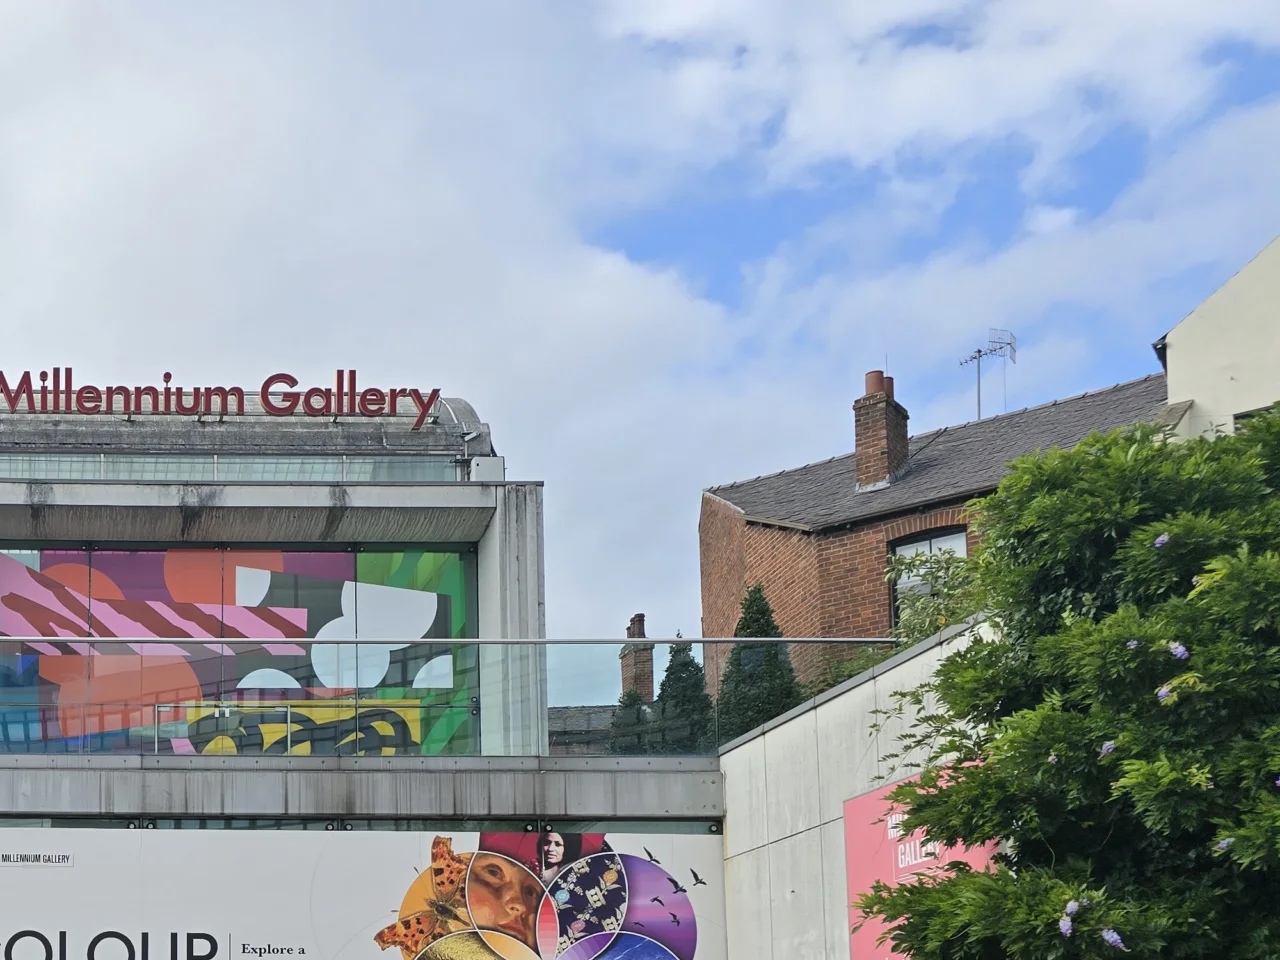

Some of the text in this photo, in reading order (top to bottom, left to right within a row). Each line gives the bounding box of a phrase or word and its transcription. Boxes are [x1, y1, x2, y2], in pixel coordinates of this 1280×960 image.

[260, 369, 441, 430] Gallery
[1, 853, 70, 864] MILLENNIUM GALLERY
[241, 943, 306, 957] Explore a
